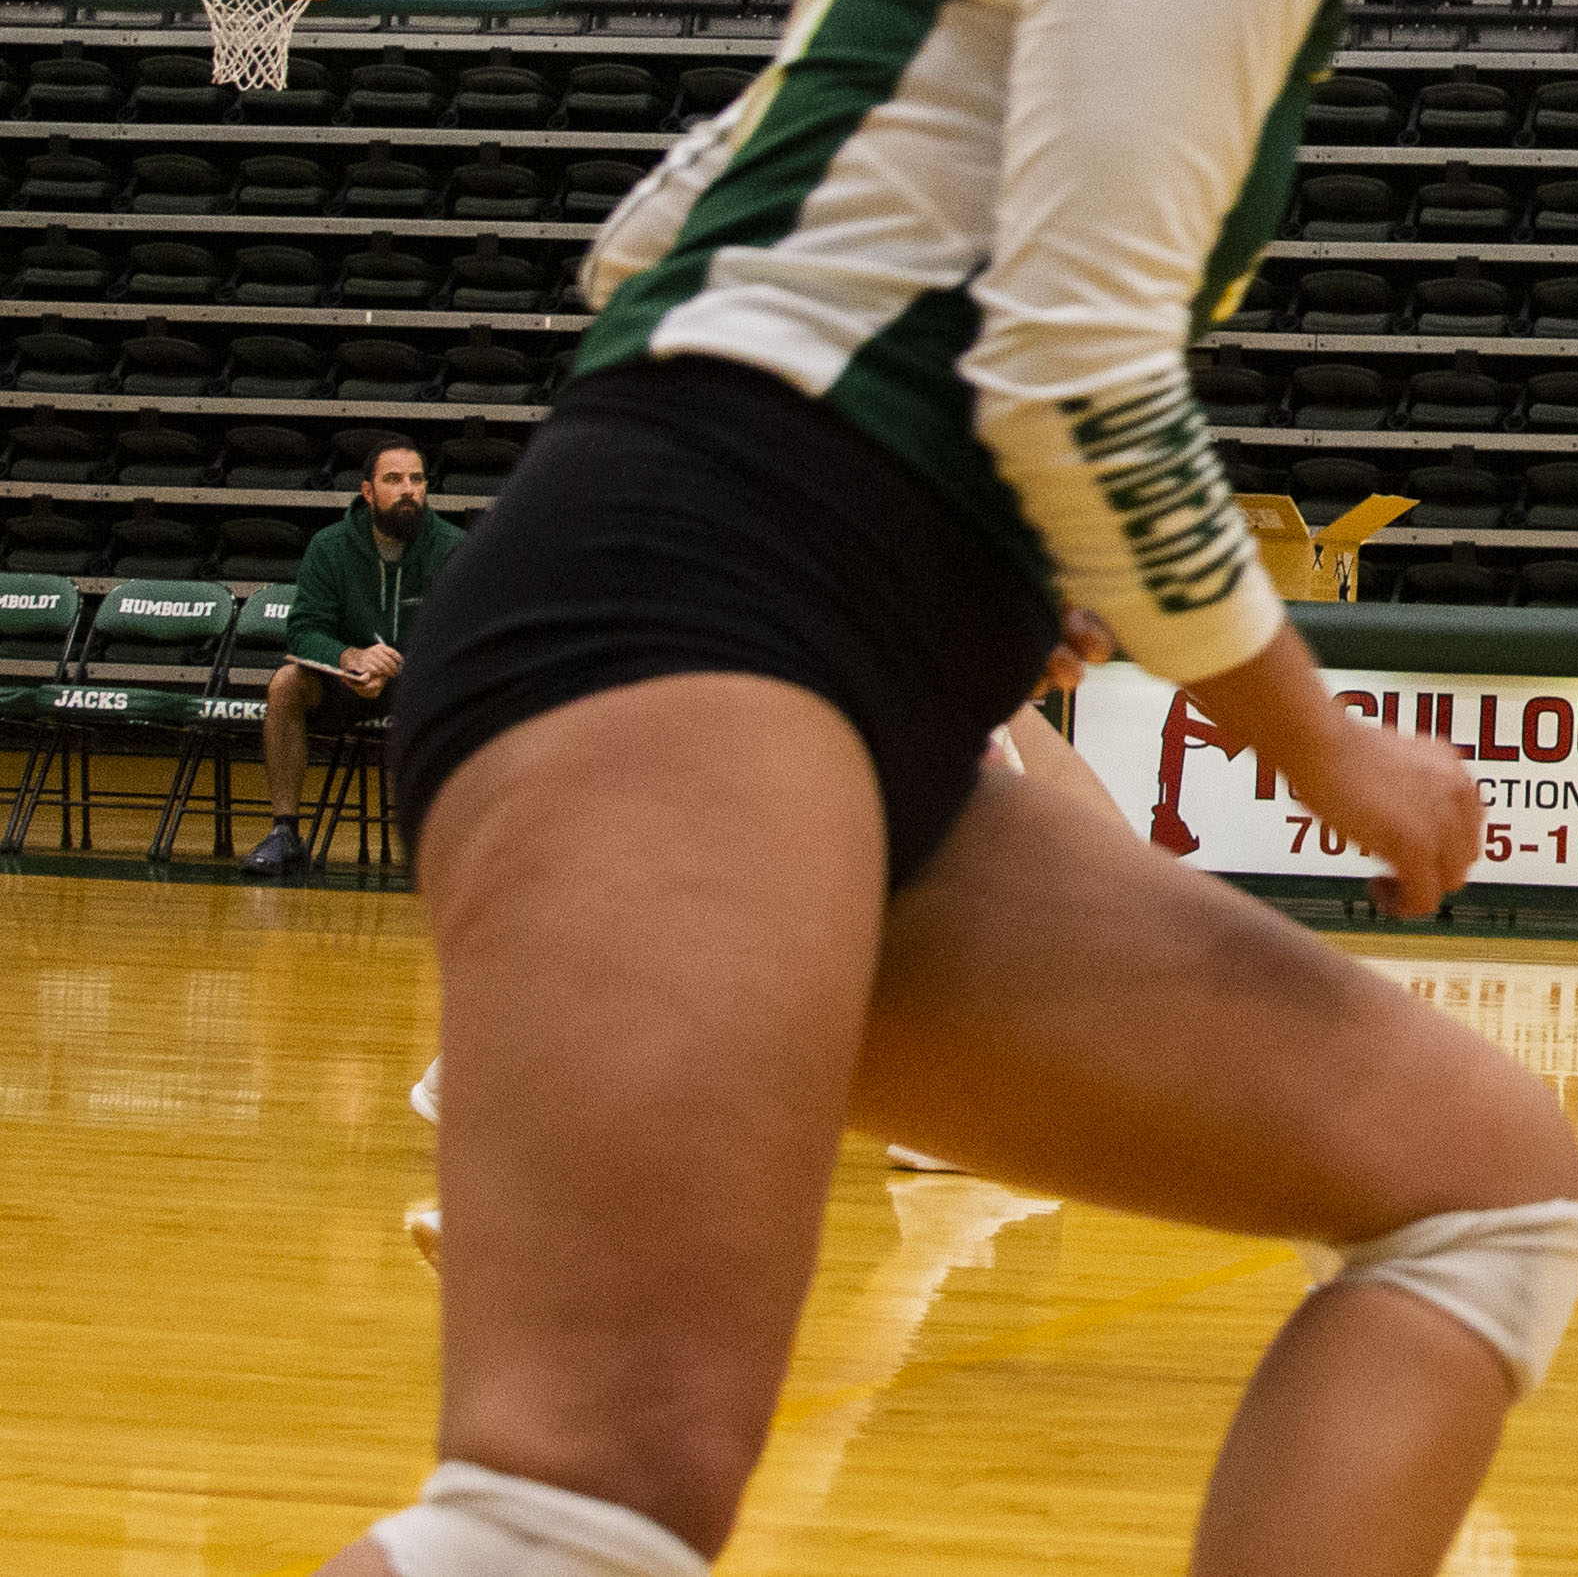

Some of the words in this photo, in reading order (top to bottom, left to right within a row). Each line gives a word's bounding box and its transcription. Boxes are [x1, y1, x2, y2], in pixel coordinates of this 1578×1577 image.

[0, 594, 61, 609] MBOLDT
[119, 598, 216, 617] HUMBOLDT
[54, 689, 128, 709] JACKS
